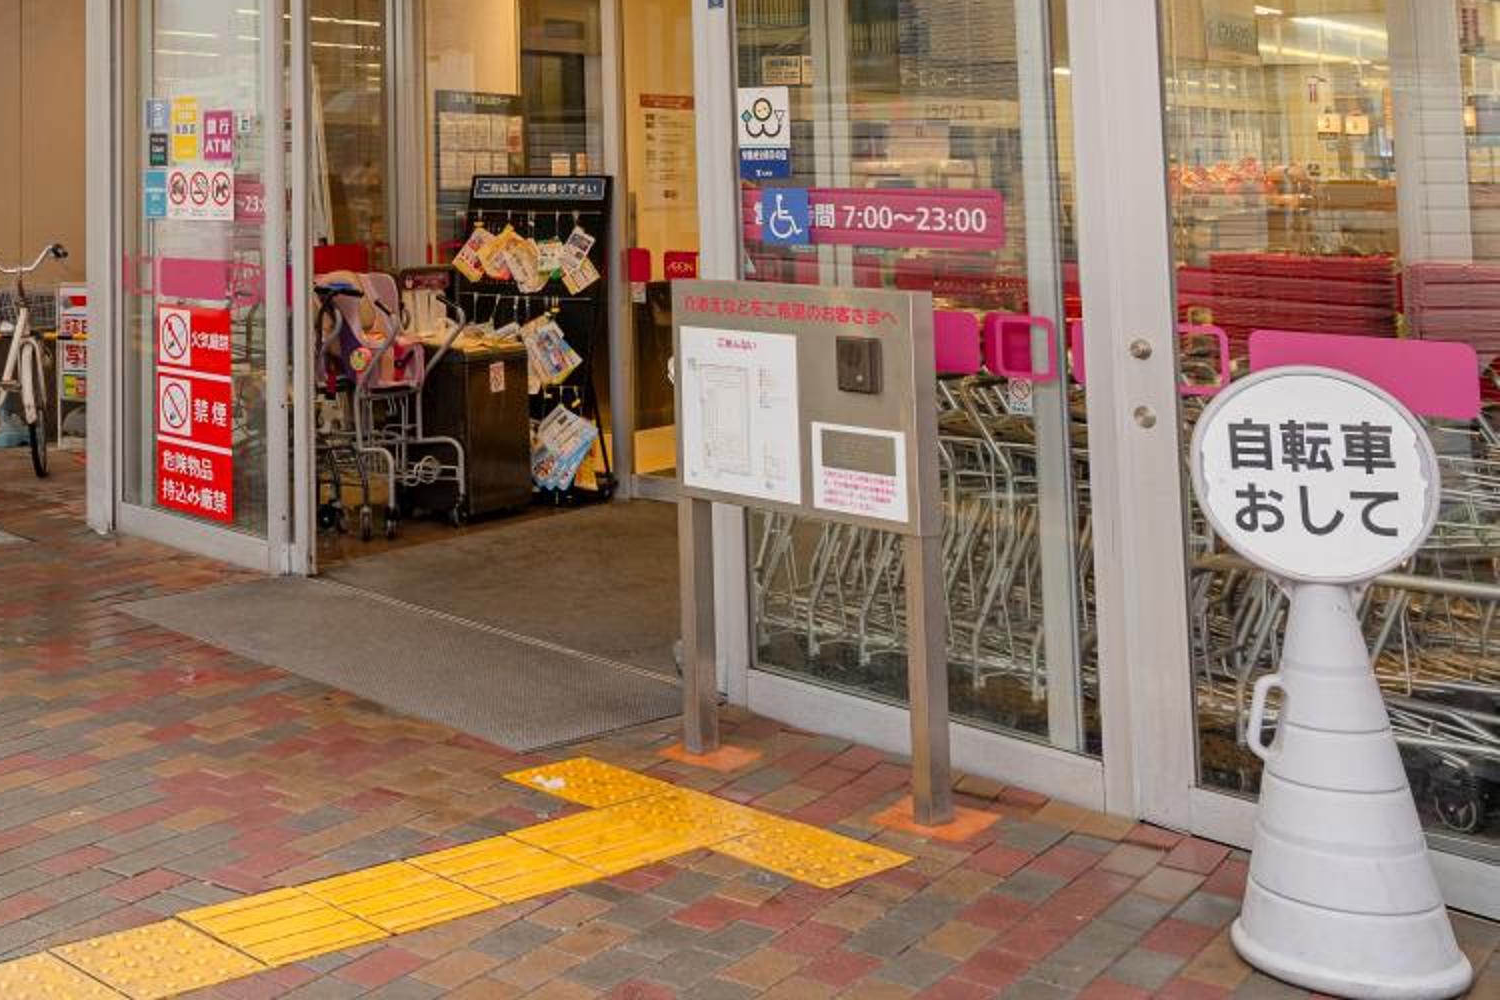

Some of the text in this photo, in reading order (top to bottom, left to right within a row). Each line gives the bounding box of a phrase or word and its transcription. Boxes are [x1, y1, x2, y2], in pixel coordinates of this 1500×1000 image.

[205, 138, 231, 154] ATM
[194, 398, 228, 428] 禁煙
[1227, 418, 1397, 474] 自転車
[162, 449, 214, 482] 危険物品
[161, 478, 228, 514] 持込み厳禁
[1235, 483, 1399, 537] おして
